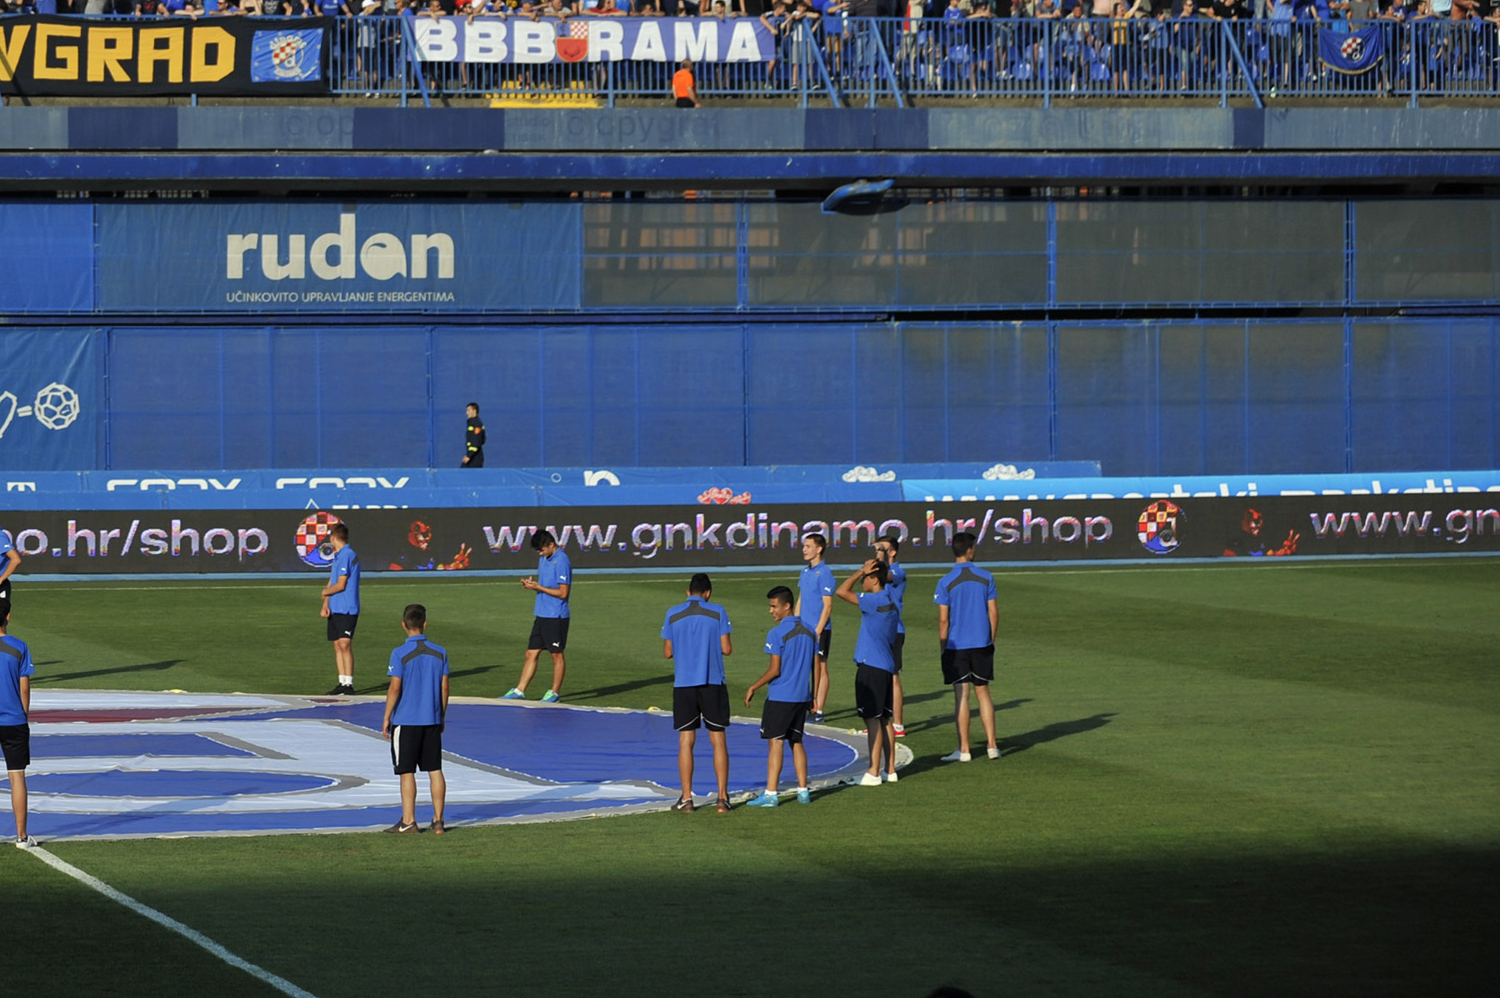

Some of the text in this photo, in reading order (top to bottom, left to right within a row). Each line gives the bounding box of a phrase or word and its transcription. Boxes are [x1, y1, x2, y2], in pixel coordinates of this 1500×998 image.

[414, 18, 763, 63] BBB RAMA
[226, 213, 456, 281] rudan
[226, 290, 456, 303] UČINKOVITO UPRAVLJANJE ENERGENTIMA
